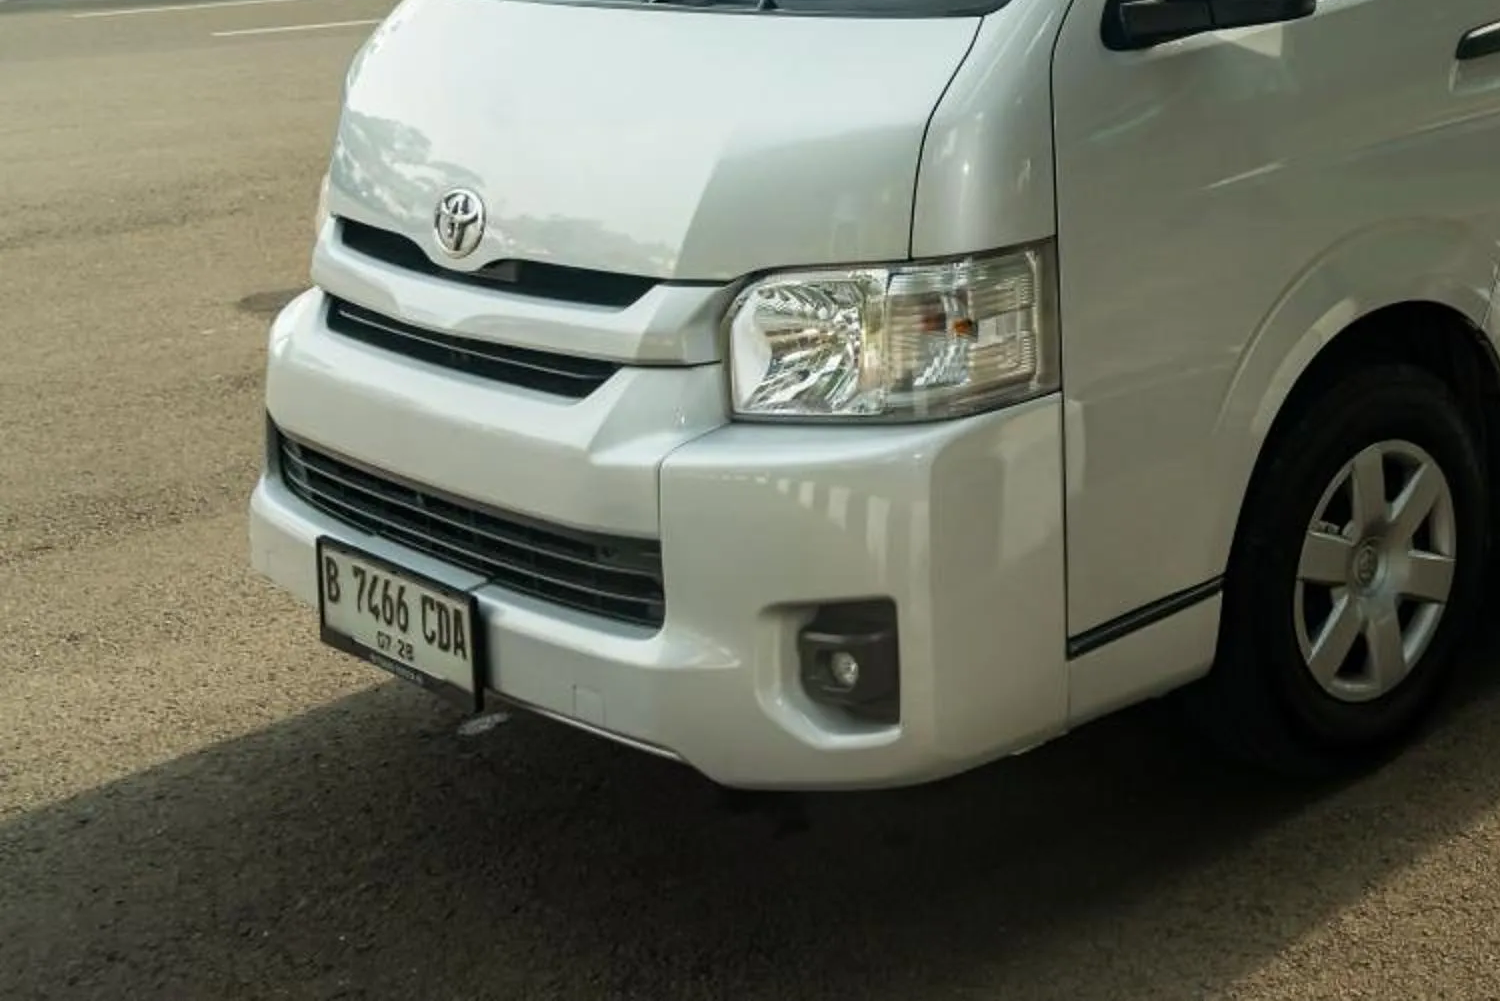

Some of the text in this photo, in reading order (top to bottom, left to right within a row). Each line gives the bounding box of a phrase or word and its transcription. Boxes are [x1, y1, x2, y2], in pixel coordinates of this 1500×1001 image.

[325, 556, 467, 660] B 7466 CDA
